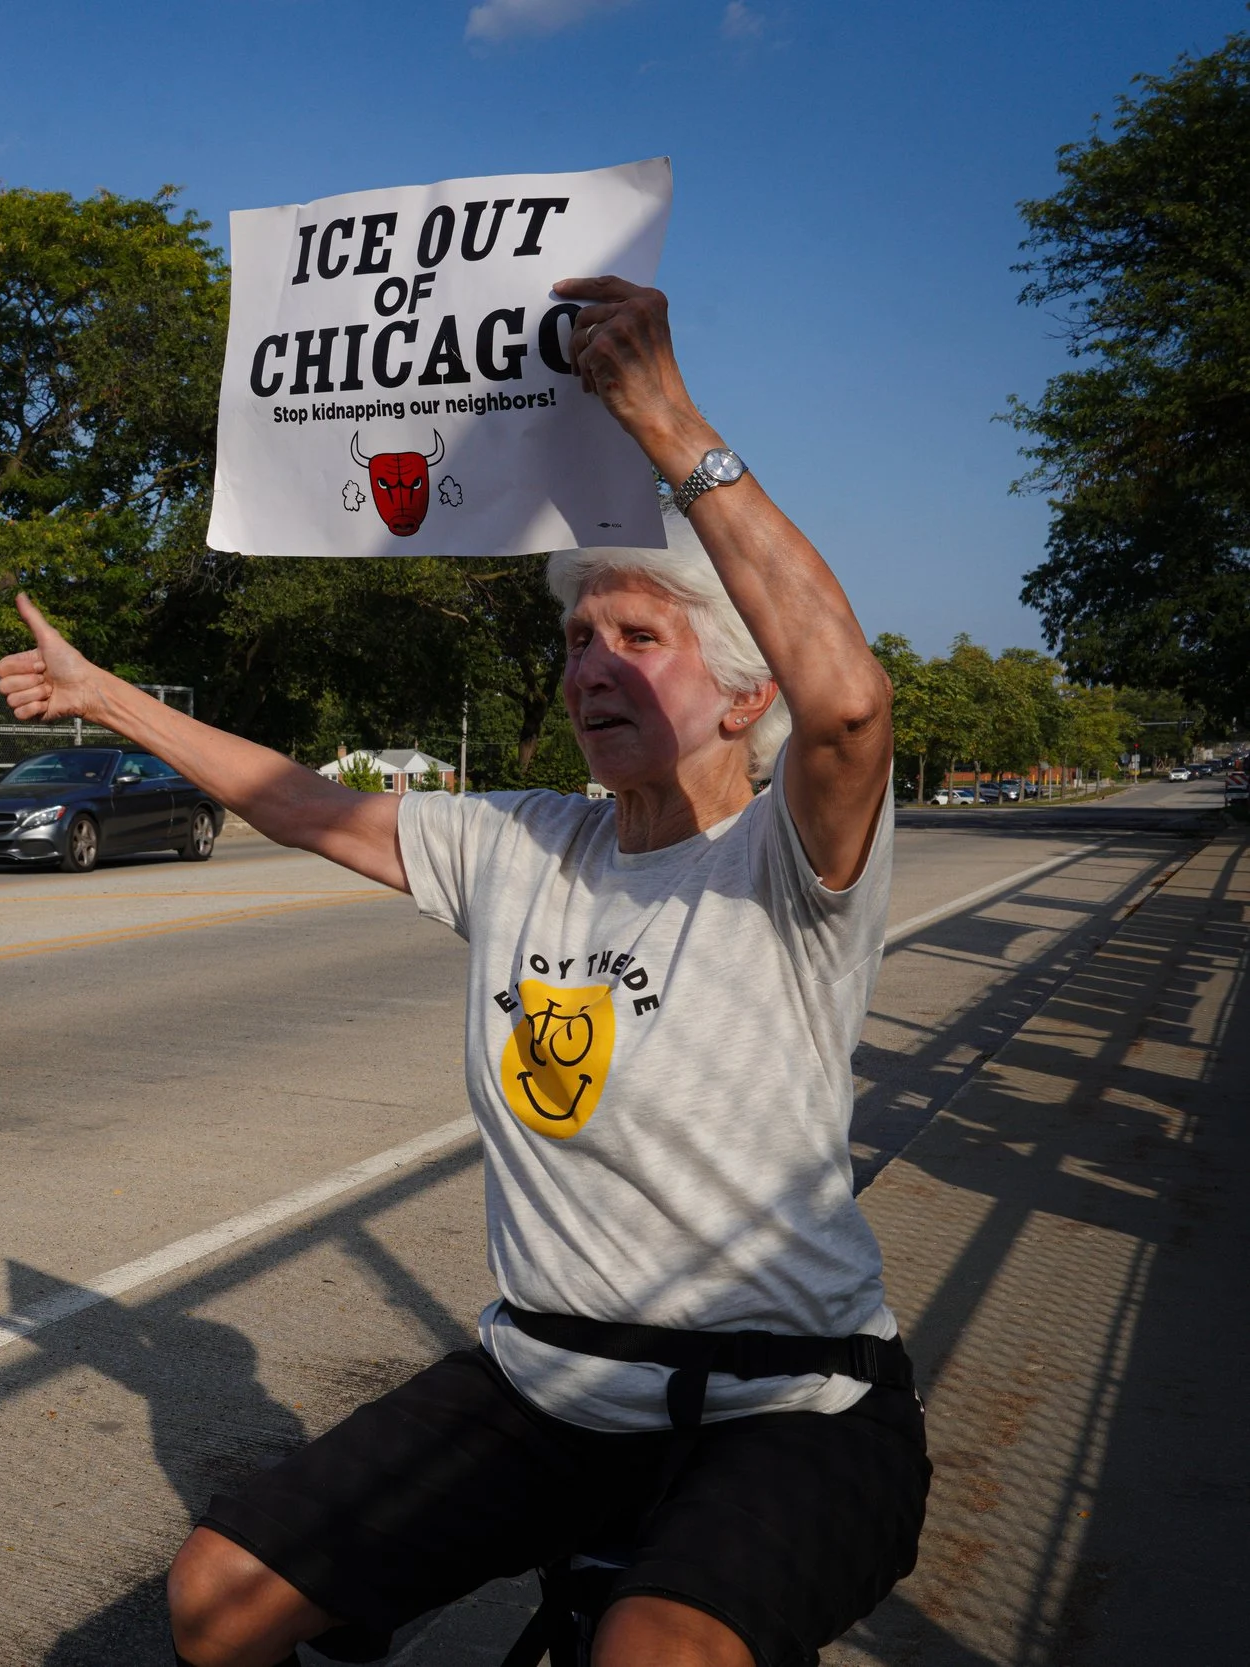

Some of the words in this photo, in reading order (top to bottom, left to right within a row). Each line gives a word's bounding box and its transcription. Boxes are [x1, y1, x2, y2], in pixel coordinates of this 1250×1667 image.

[292, 212, 398, 285] ICE
[417, 197, 570, 269] OUT
[374, 272, 436, 317] OF
[250, 303, 583, 398] CHICAGO
[273, 406, 308, 425] Stop
[312, 399, 405, 422] kidnapping
[410, 399, 440, 416] our
[446, 388, 556, 416] neighbors!
[493, 953, 575, 1013] EOY
[587, 951, 630, 977] THE
